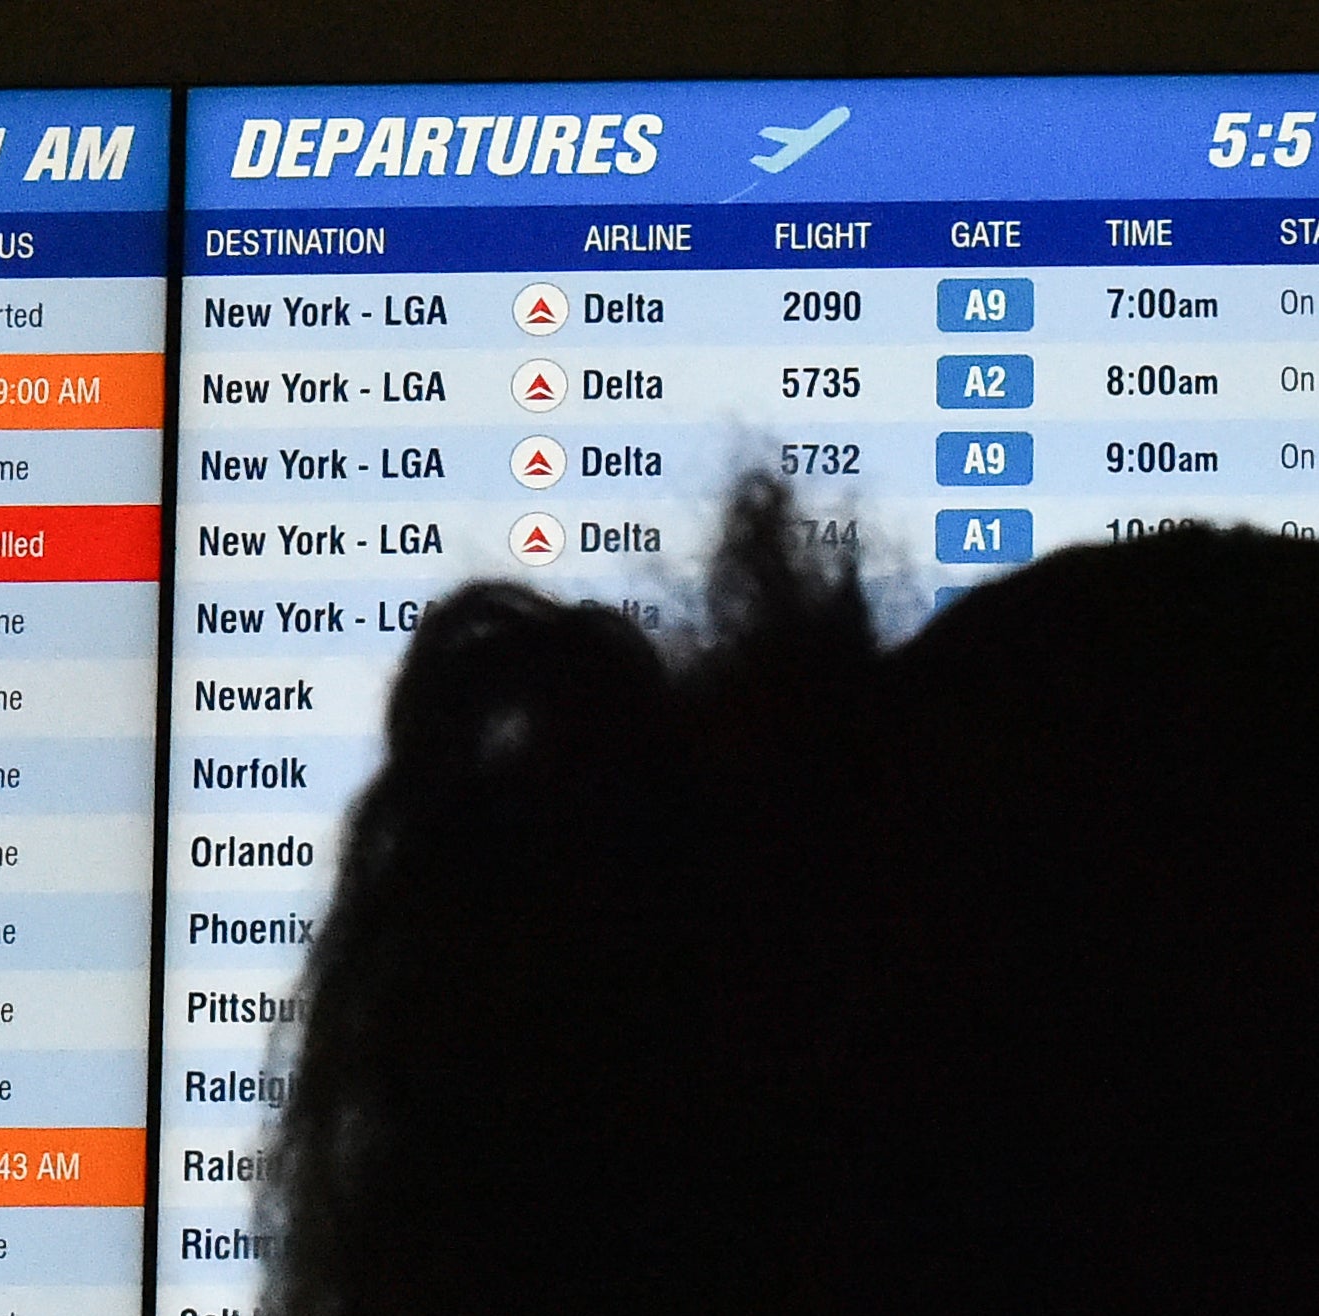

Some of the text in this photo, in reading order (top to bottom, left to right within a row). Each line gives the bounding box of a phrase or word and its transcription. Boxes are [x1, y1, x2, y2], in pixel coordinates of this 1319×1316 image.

[22, 125, 136, 182] AM
[230, 113, 664, 179] DEPARTURES
[205, 227, 385, 257] DESTINATION
[583, 223, 692, 252] AIRLINE
[774, 221, 873, 250] FLIGHT
[950, 220, 1022, 249] GATE
[1104, 218, 1173, 247] TIME
[205, 297, 272, 329] New
[282, 296, 351, 328] York
[385, 294, 448, 326] LGA
[584, 292, 664, 324] Delta
[783, 290, 862, 322] 2090
[964, 288, 1007, 321] A9
[1106, 287, 1218, 319] 7:00am
[1280, 289, 1314, 315] On
[57, 376, 101, 405] AM
[195, 679, 313, 712] Newark
[193, 757, 307, 790] Norfolk
[190, 835, 314, 868] Orlando
[189, 912, 313, 945] Phoenix
[36, 1151, 80, 1181] AM
